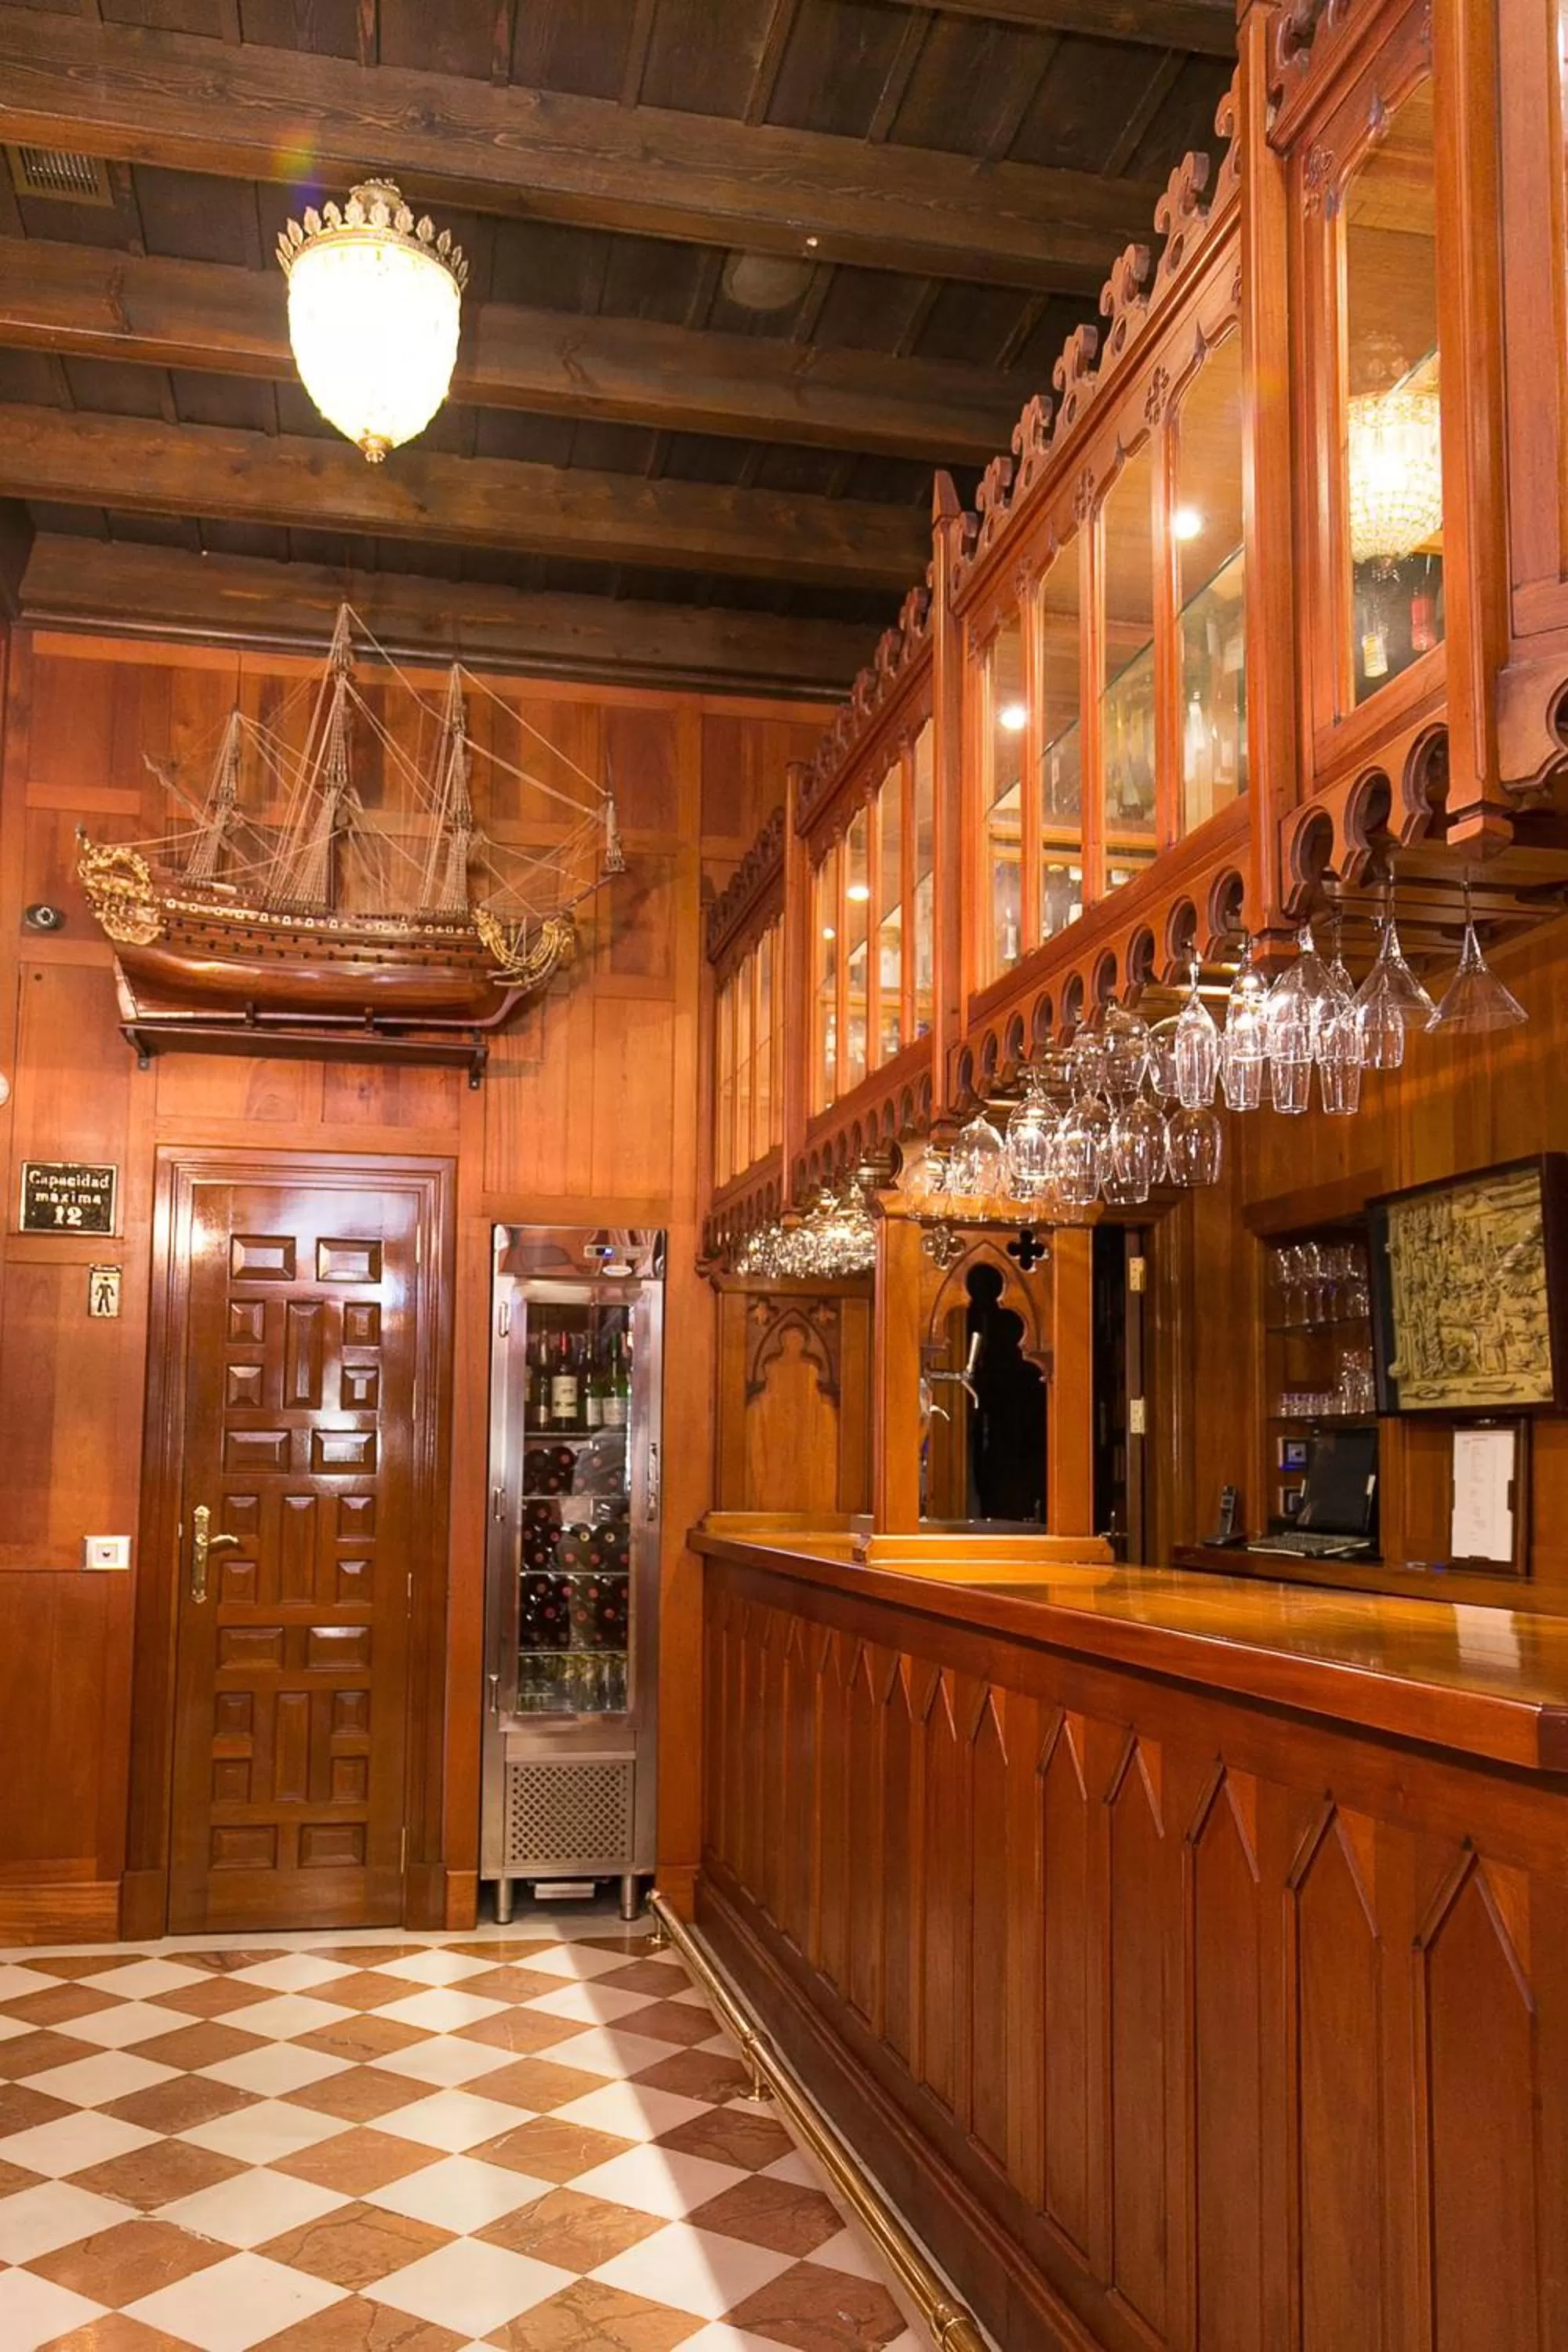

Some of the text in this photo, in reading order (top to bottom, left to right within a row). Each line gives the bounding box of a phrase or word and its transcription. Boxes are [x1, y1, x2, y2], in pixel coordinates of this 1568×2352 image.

[28, 1171, 110, 1189] Capacidad
[35, 1189, 102, 1204] máxima
[53, 1205, 83, 1226] 12
